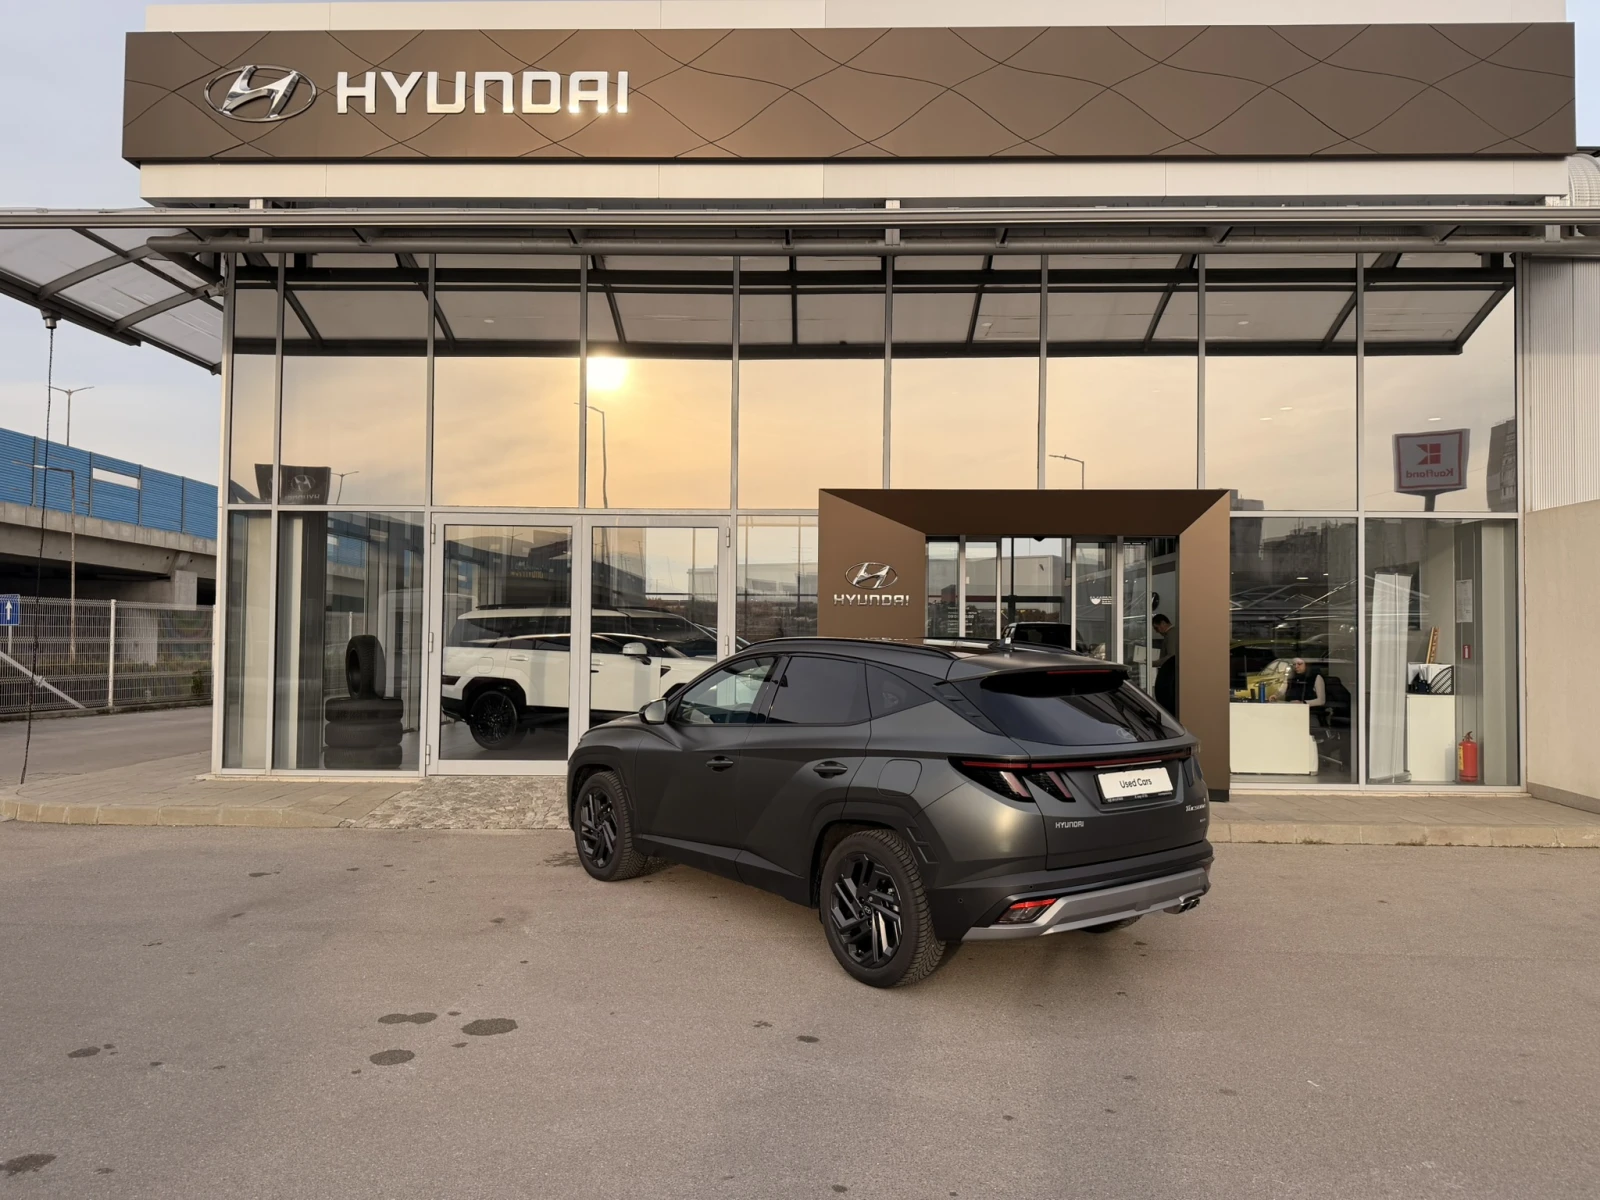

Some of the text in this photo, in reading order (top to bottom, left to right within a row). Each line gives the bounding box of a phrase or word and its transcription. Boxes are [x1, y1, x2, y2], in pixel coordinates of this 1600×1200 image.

[337, 71, 629, 114] HYUNDAI
[833, 594, 910, 606] HYUNDAI
[1119, 778, 1152, 788] Used Cars
[1055, 820, 1085, 829] HYUNDAI
